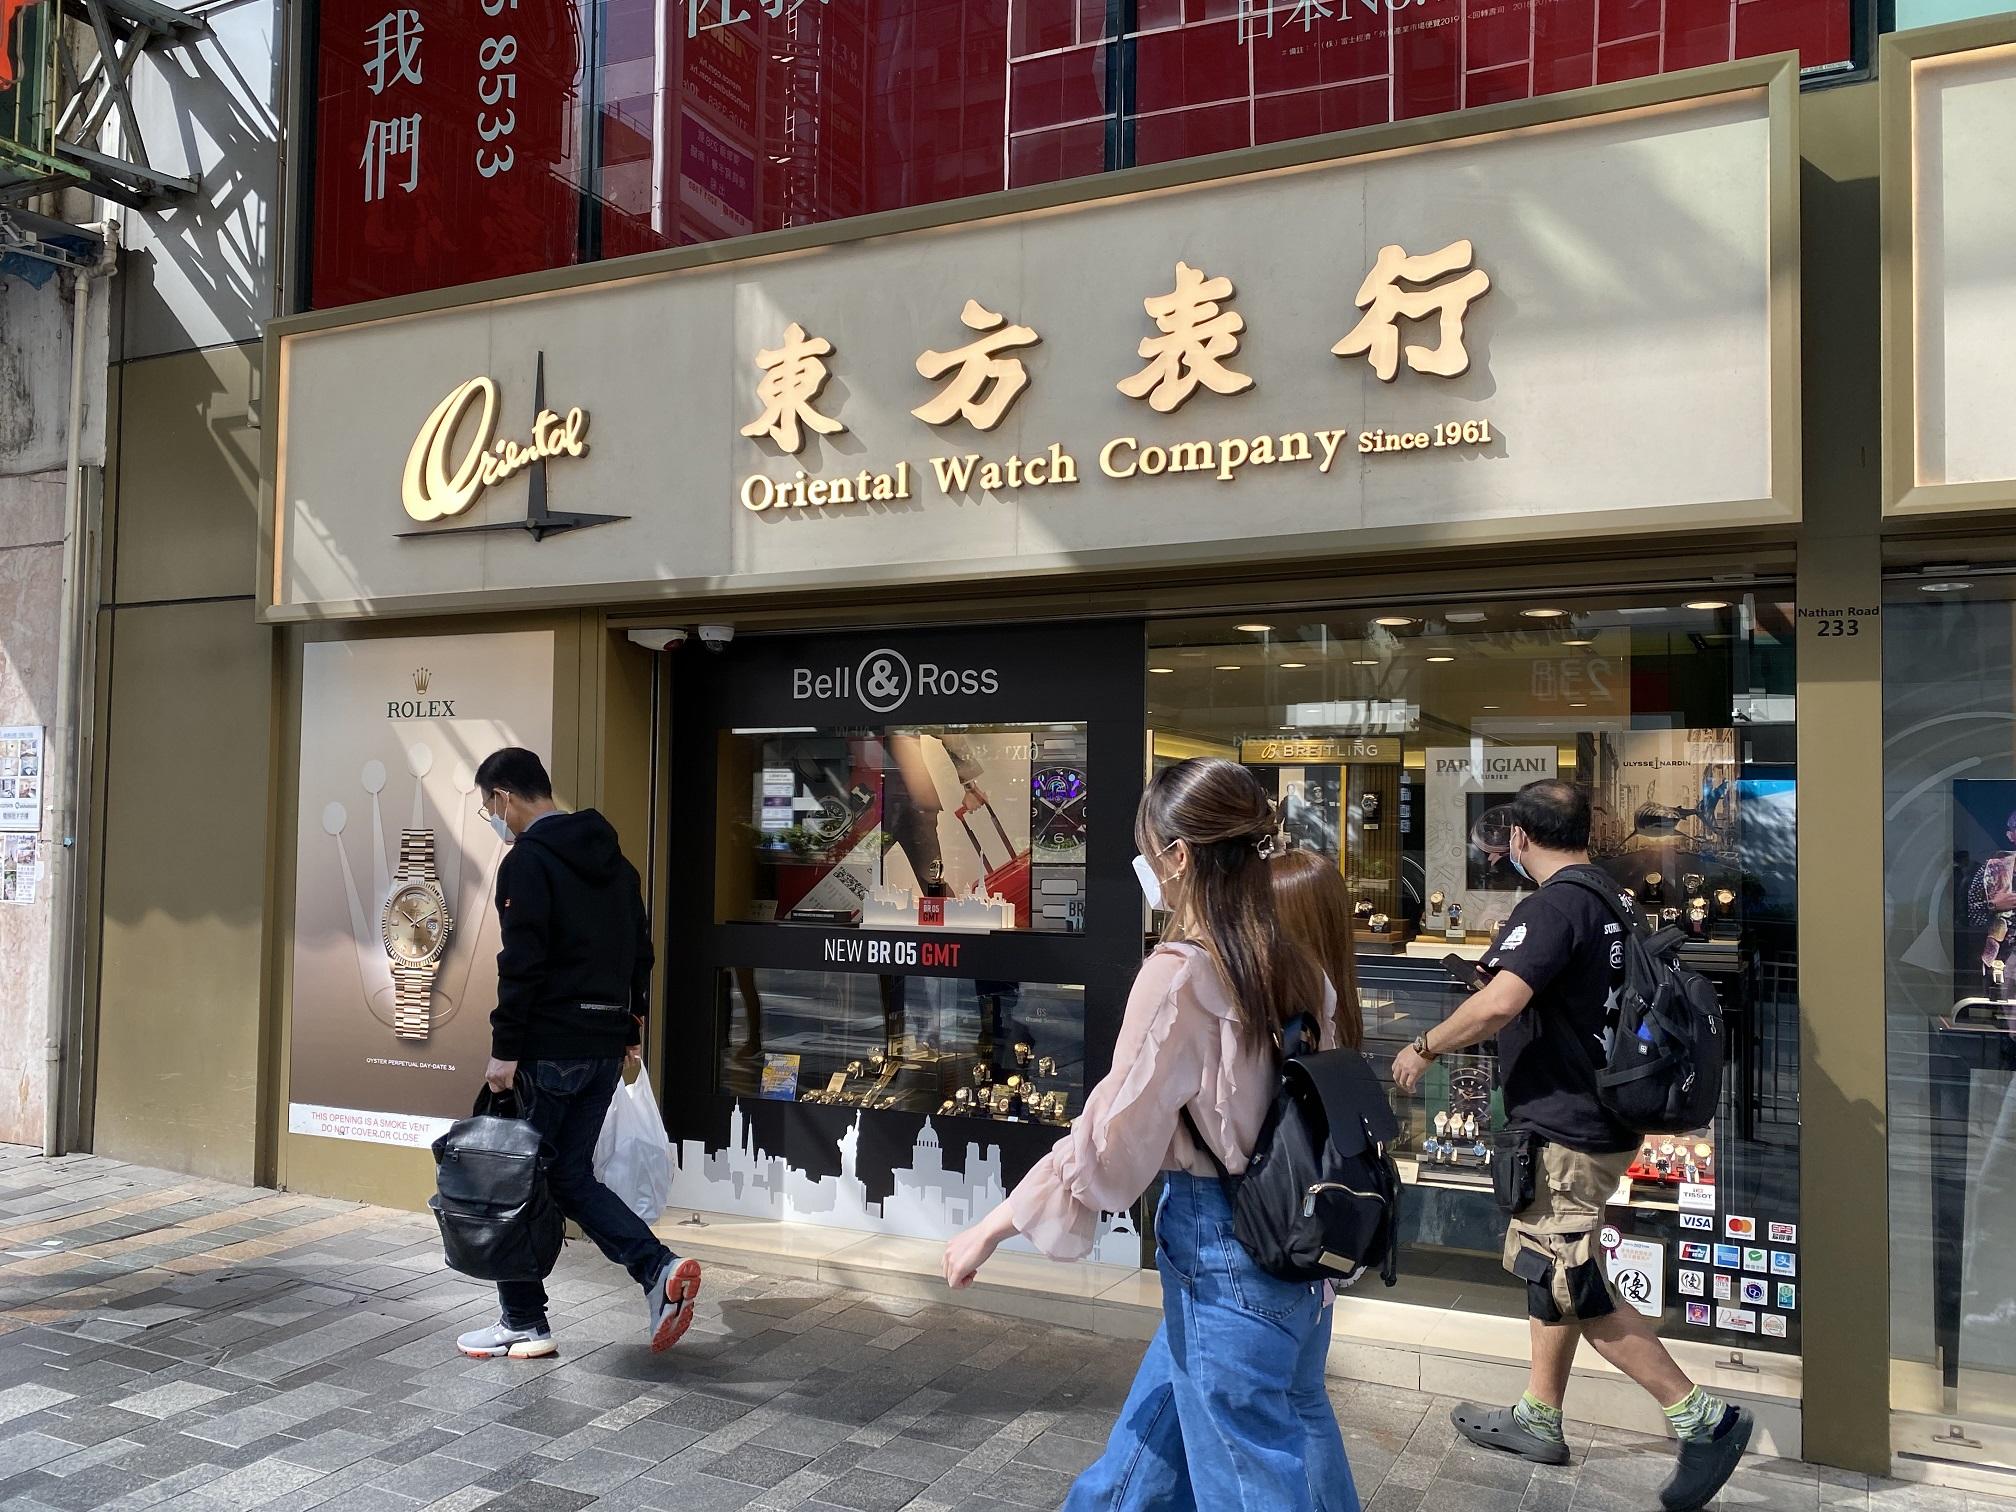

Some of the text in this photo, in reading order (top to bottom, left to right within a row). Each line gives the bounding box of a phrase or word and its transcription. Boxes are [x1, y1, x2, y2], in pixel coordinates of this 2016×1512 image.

[358, 9, 425, 202] 我們
[477, 35, 518, 178] 8533
[741, 239, 1492, 453] 東方表行
[401, 376, 590, 522] Oriental
[740, 418, 1493, 512] Oriental Watch Company Since 1961
[1798, 605, 1880, 618] Nathan Road
[1817, 619, 1859, 637] 233
[793, 666, 849, 699] Bell
[918, 663, 1000, 696] Ross
[387, 700, 456, 719] ROLEX
[1283, 744, 1378, 757] BREITLING
[824, 938, 961, 967] NEW BR 05 GMT
[366, 1057, 388, 1065] OYSTER
[388, 1059, 419, 1068] PERPETUAL
[419, 1062, 447, 1071] DAY-DATE
[312, 1111, 430, 1133] THIS OPENING IS A SMOKE VENT
[321, 1123, 333, 1133] DO
[334, 1124, 350, 1135] NOT
[392, 1130, 419, 1143] CLOSE
[1683, 1191, 1713, 1199] TISSOT
[1684, 1216, 1712, 1229] VISA
[1772, 1224, 1793, 1235] EPS
